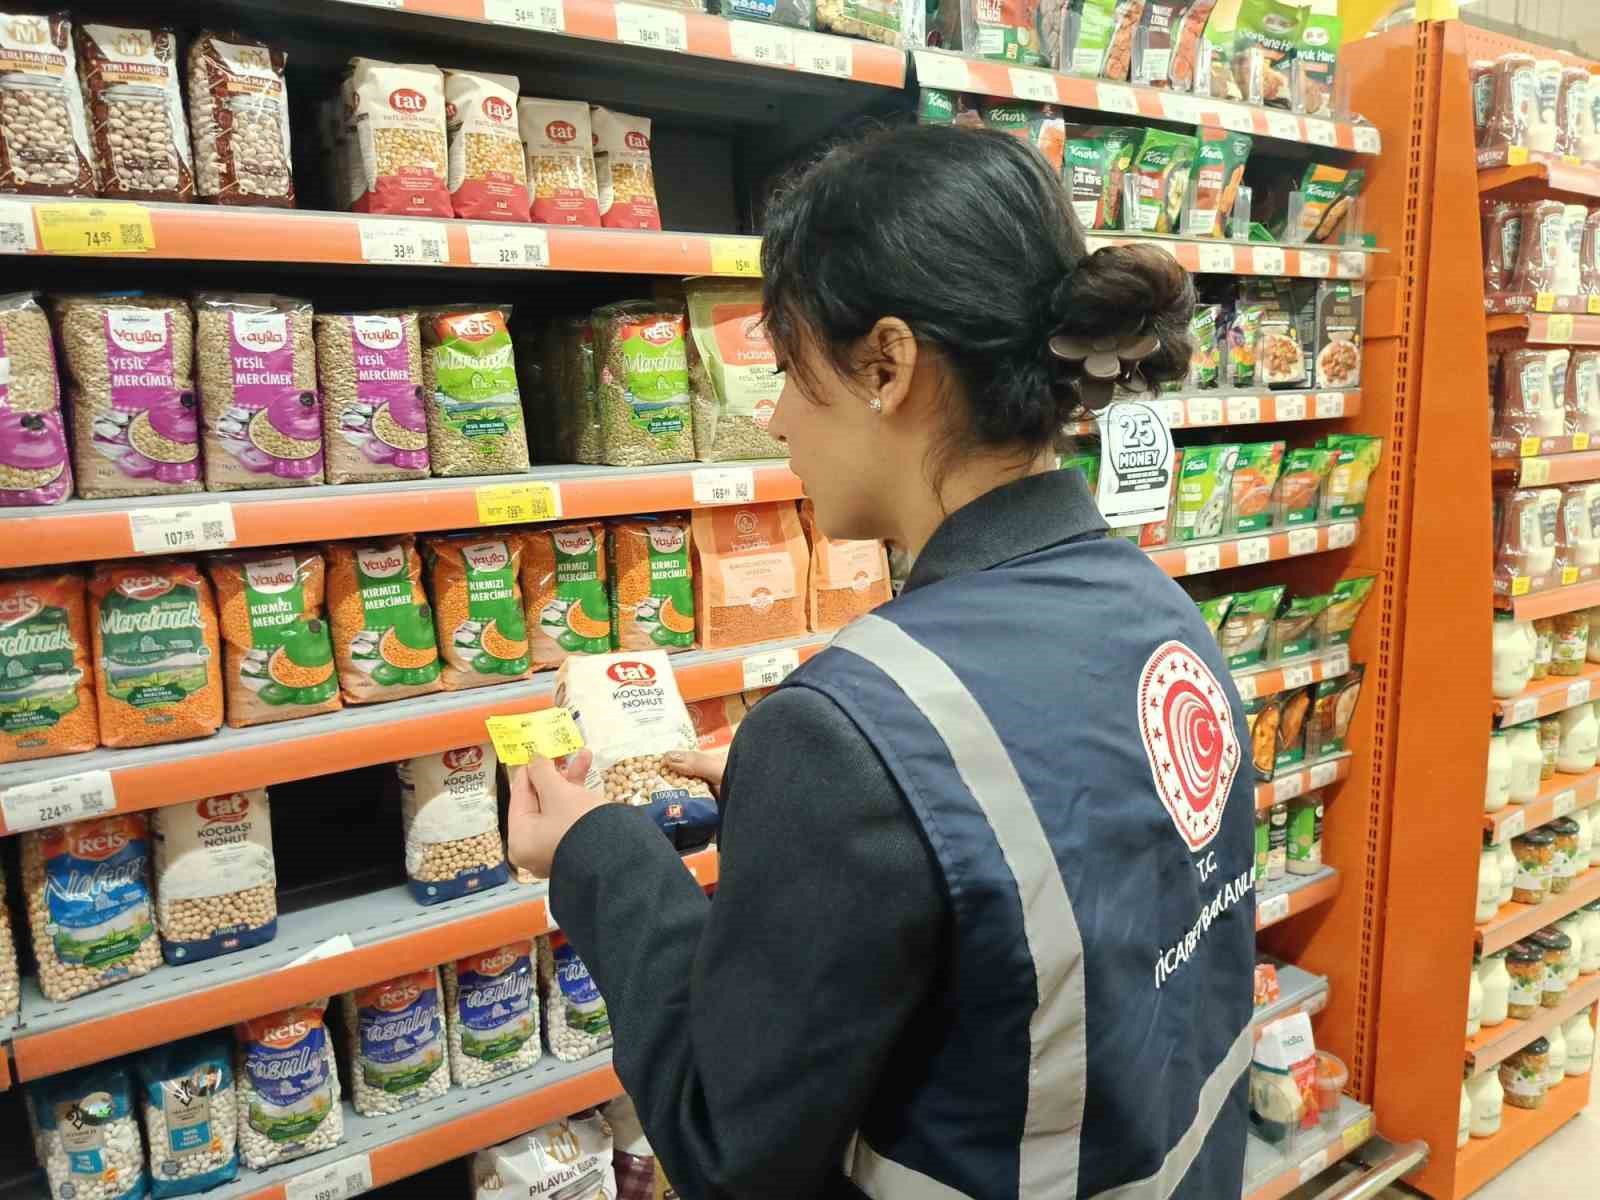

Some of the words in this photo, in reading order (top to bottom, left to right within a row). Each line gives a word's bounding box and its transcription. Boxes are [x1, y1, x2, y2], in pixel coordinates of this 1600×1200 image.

[394, 92, 422, 109] tat
[487, 102, 512, 118] tat
[988, 109, 1026, 122] Knorr
[549, 122, 576, 138] tat
[628, 136, 649, 149] tat
[113, 329, 163, 345] Yayla
[111, 356, 145, 371] YEŞİL
[234, 356, 265, 371] YEŞİL
[358, 353, 385, 367] YEŞİL
[112, 373, 174, 387] MERCİMEK
[235, 372, 292, 385] MERCİMEK
[359, 367, 409, 381] MERCİMEK
[1119, 414, 1157, 449] 25
[1118, 449, 1160, 470] MONEY
[363, 557, 402, 573] Yayla
[471, 552, 506, 566] Yayla
[652, 559, 680, 570] KIRMIZI
[558, 562, 589, 573] KIRMIZI
[652, 568, 687, 580] MERCİMEK
[251, 573, 294, 588] Yayla
[469, 579, 504, 591] KIRMIZI
[362, 585, 401, 599] KIRMIZI
[471, 589, 512, 602] MERCİMEK
[251, 602, 292, 616] KIRMIZI
[364, 594, 412, 610] MERCİMEK
[615, 663, 651, 680] tat
[612, 688, 665, 700] KOÇBAŞI
[622, 698, 664, 709] NOHUT
[197, 822, 252, 839] KOÇBAŞI
[78, 832, 126, 853] Reis
[204, 833, 249, 848] NOHUT
